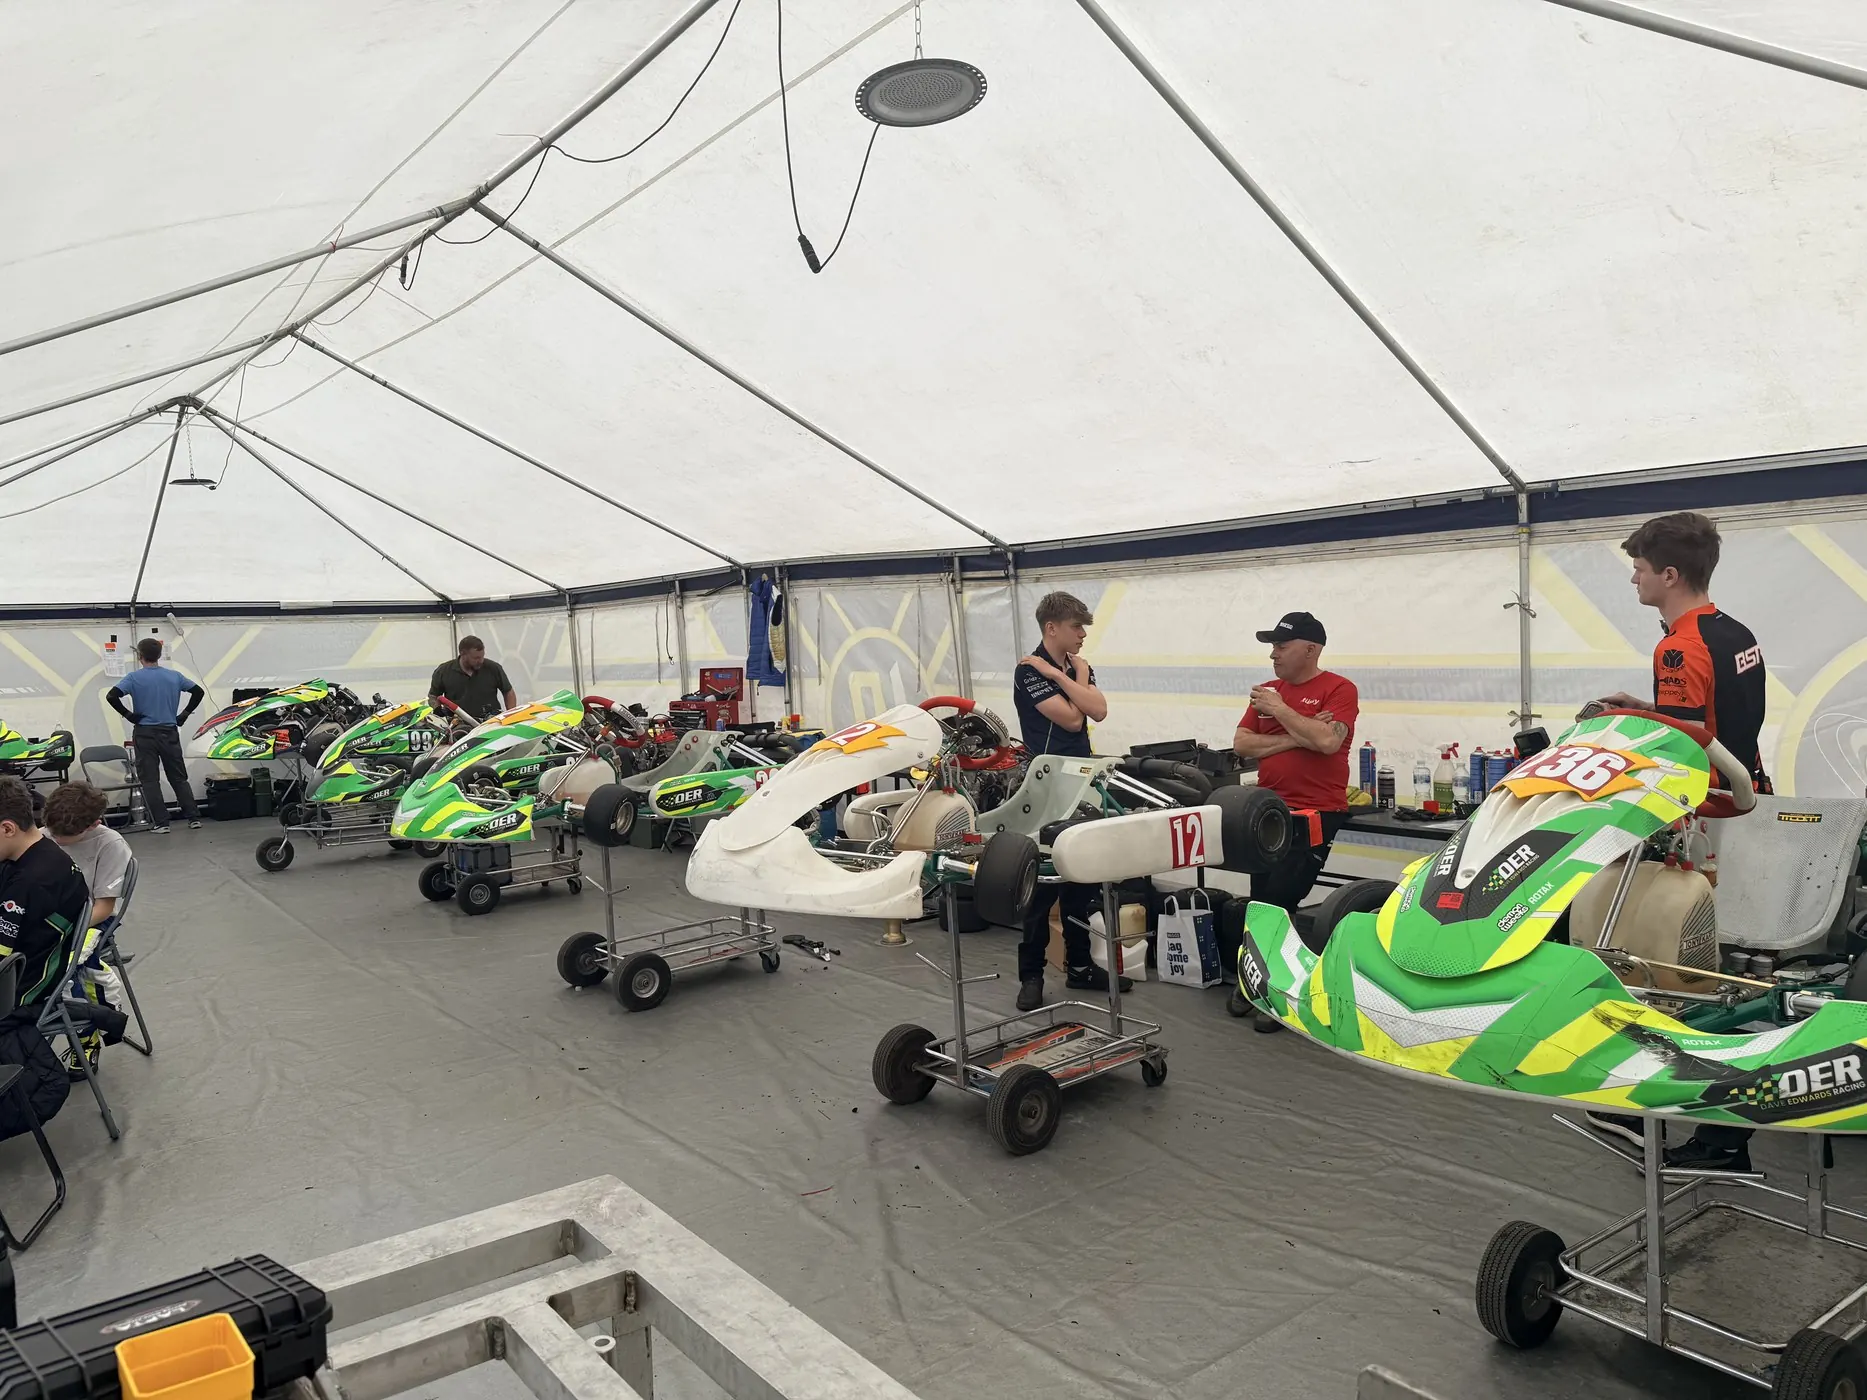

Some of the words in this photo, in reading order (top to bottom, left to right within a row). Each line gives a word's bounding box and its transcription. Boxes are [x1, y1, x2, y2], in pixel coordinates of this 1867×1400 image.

[1173, 814, 1205, 866] 12
[1528, 881, 1555, 905] ROTAX
[1170, 962, 1185, 976] joy
[1681, 1038, 1721, 1046] ROTAX
[1760, 1100, 1786, 1110] DAVE
[1786, 1090, 1832, 1106] EDWARDS
[1832, 1081, 1867, 1096] RACING
